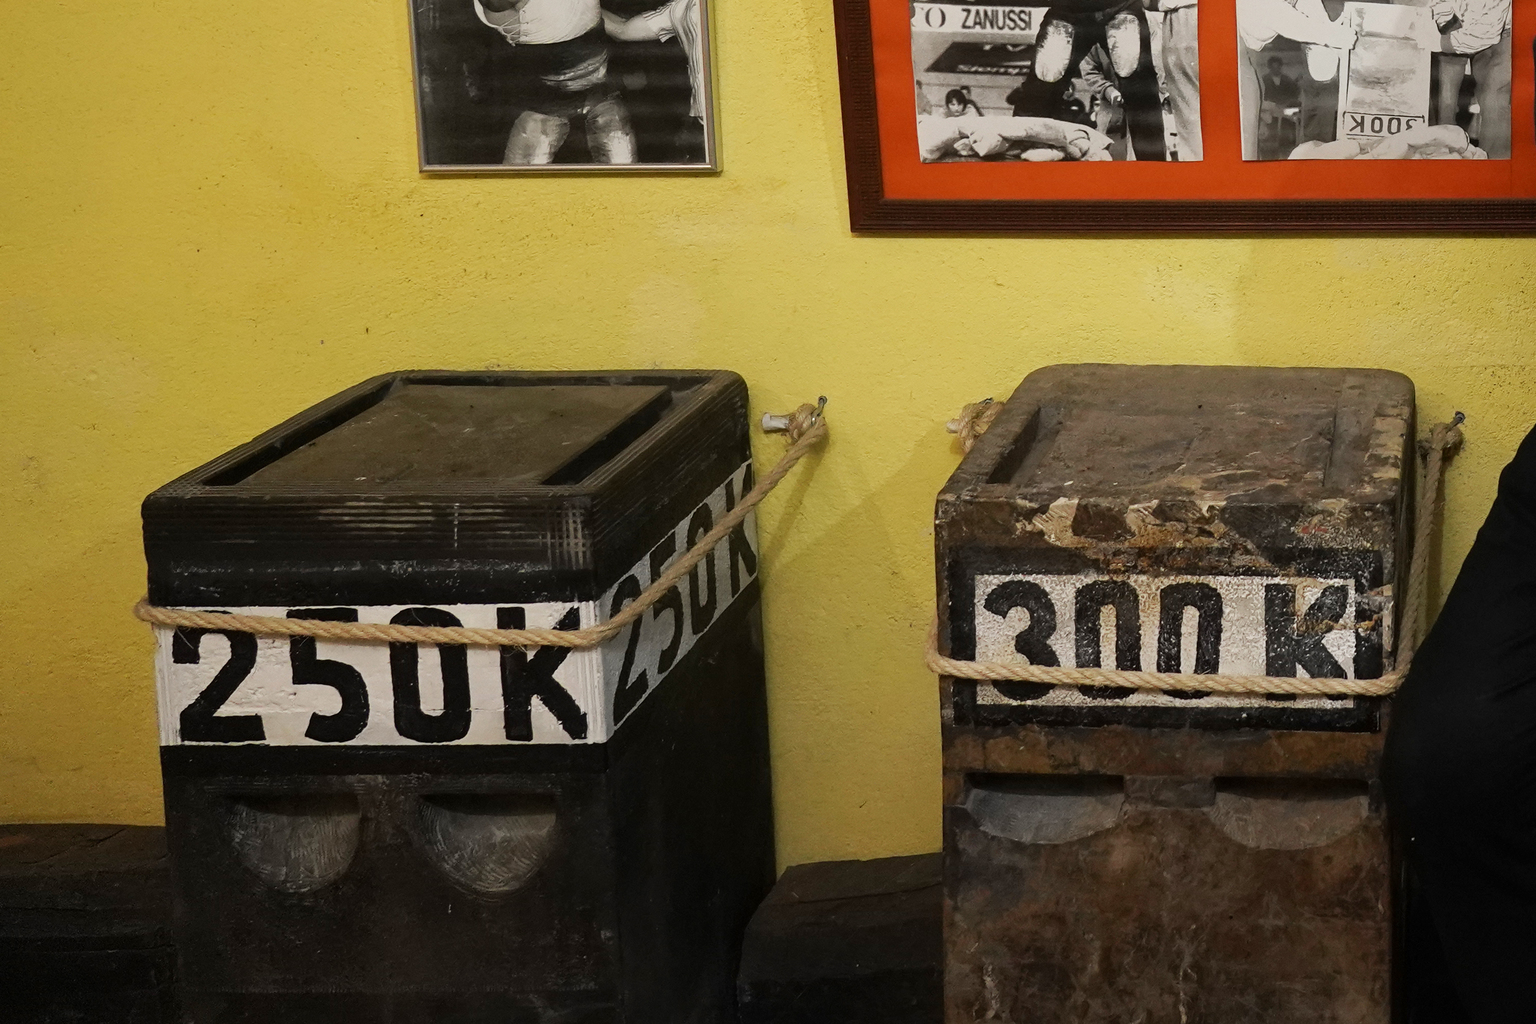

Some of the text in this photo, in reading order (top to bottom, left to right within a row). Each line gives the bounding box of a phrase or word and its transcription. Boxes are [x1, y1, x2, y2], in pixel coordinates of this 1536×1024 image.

[919, 7, 1032, 31] O ZANUSSI
[606, 466, 757, 728] 250K
[982, 579, 1350, 702] 300K
[171, 606, 588, 744] 250K
